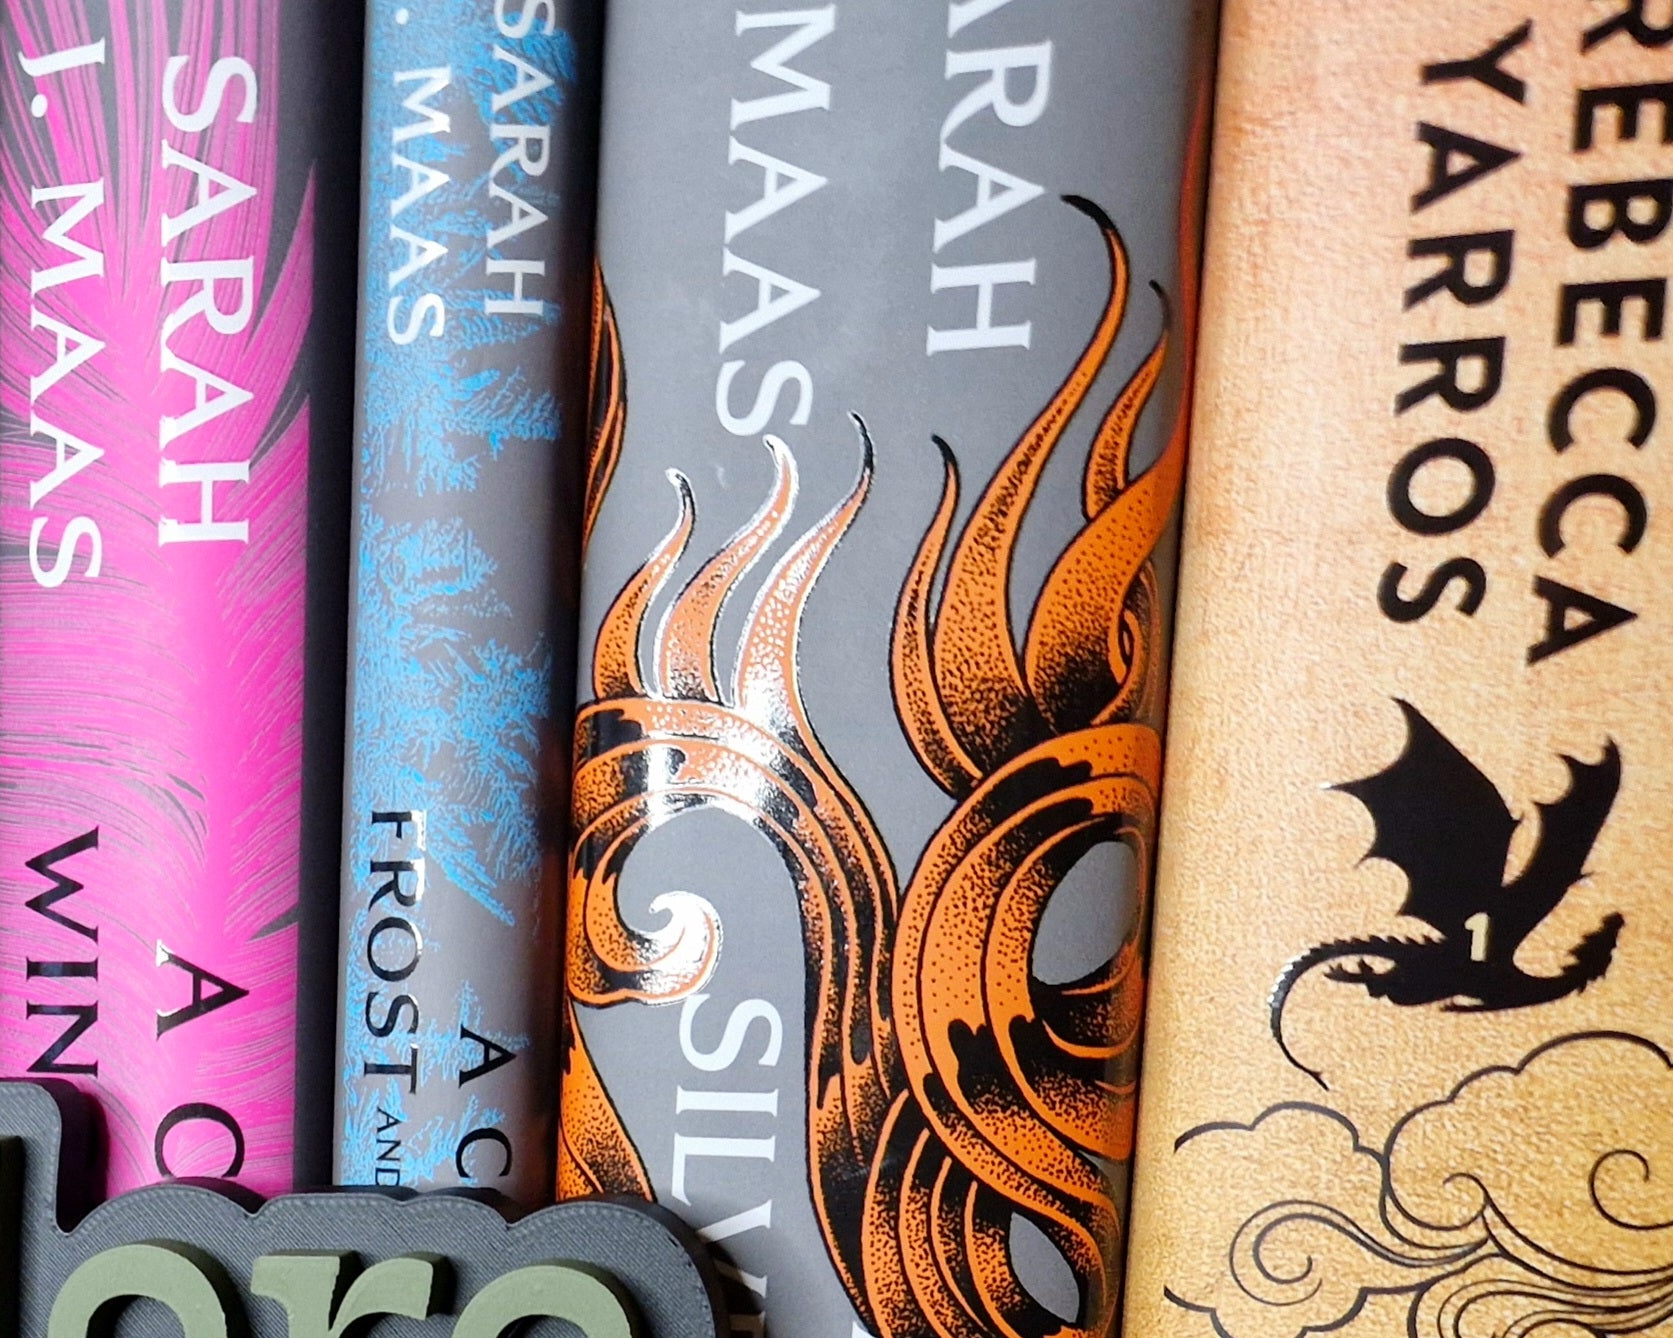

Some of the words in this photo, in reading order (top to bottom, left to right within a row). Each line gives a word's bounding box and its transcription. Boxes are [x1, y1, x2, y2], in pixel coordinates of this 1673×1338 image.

[18, 37, 105, 119] J.
[387, 66, 452, 346] MAAS
[484, 0, 555, 316] SARAH
[715, 6, 836, 437] MAAS
[926, 0, 1053, 356] RAH
[28, 177, 105, 589] MAAS
[158, 54, 257, 546] SARAH
[1376, 19, 1533, 624] YARROS
[24, 825, 99, 1078] WIN
[155, 939, 250, 1041] A
[363, 809, 426, 1093] FROST
[458, 1025, 517, 1089] A
